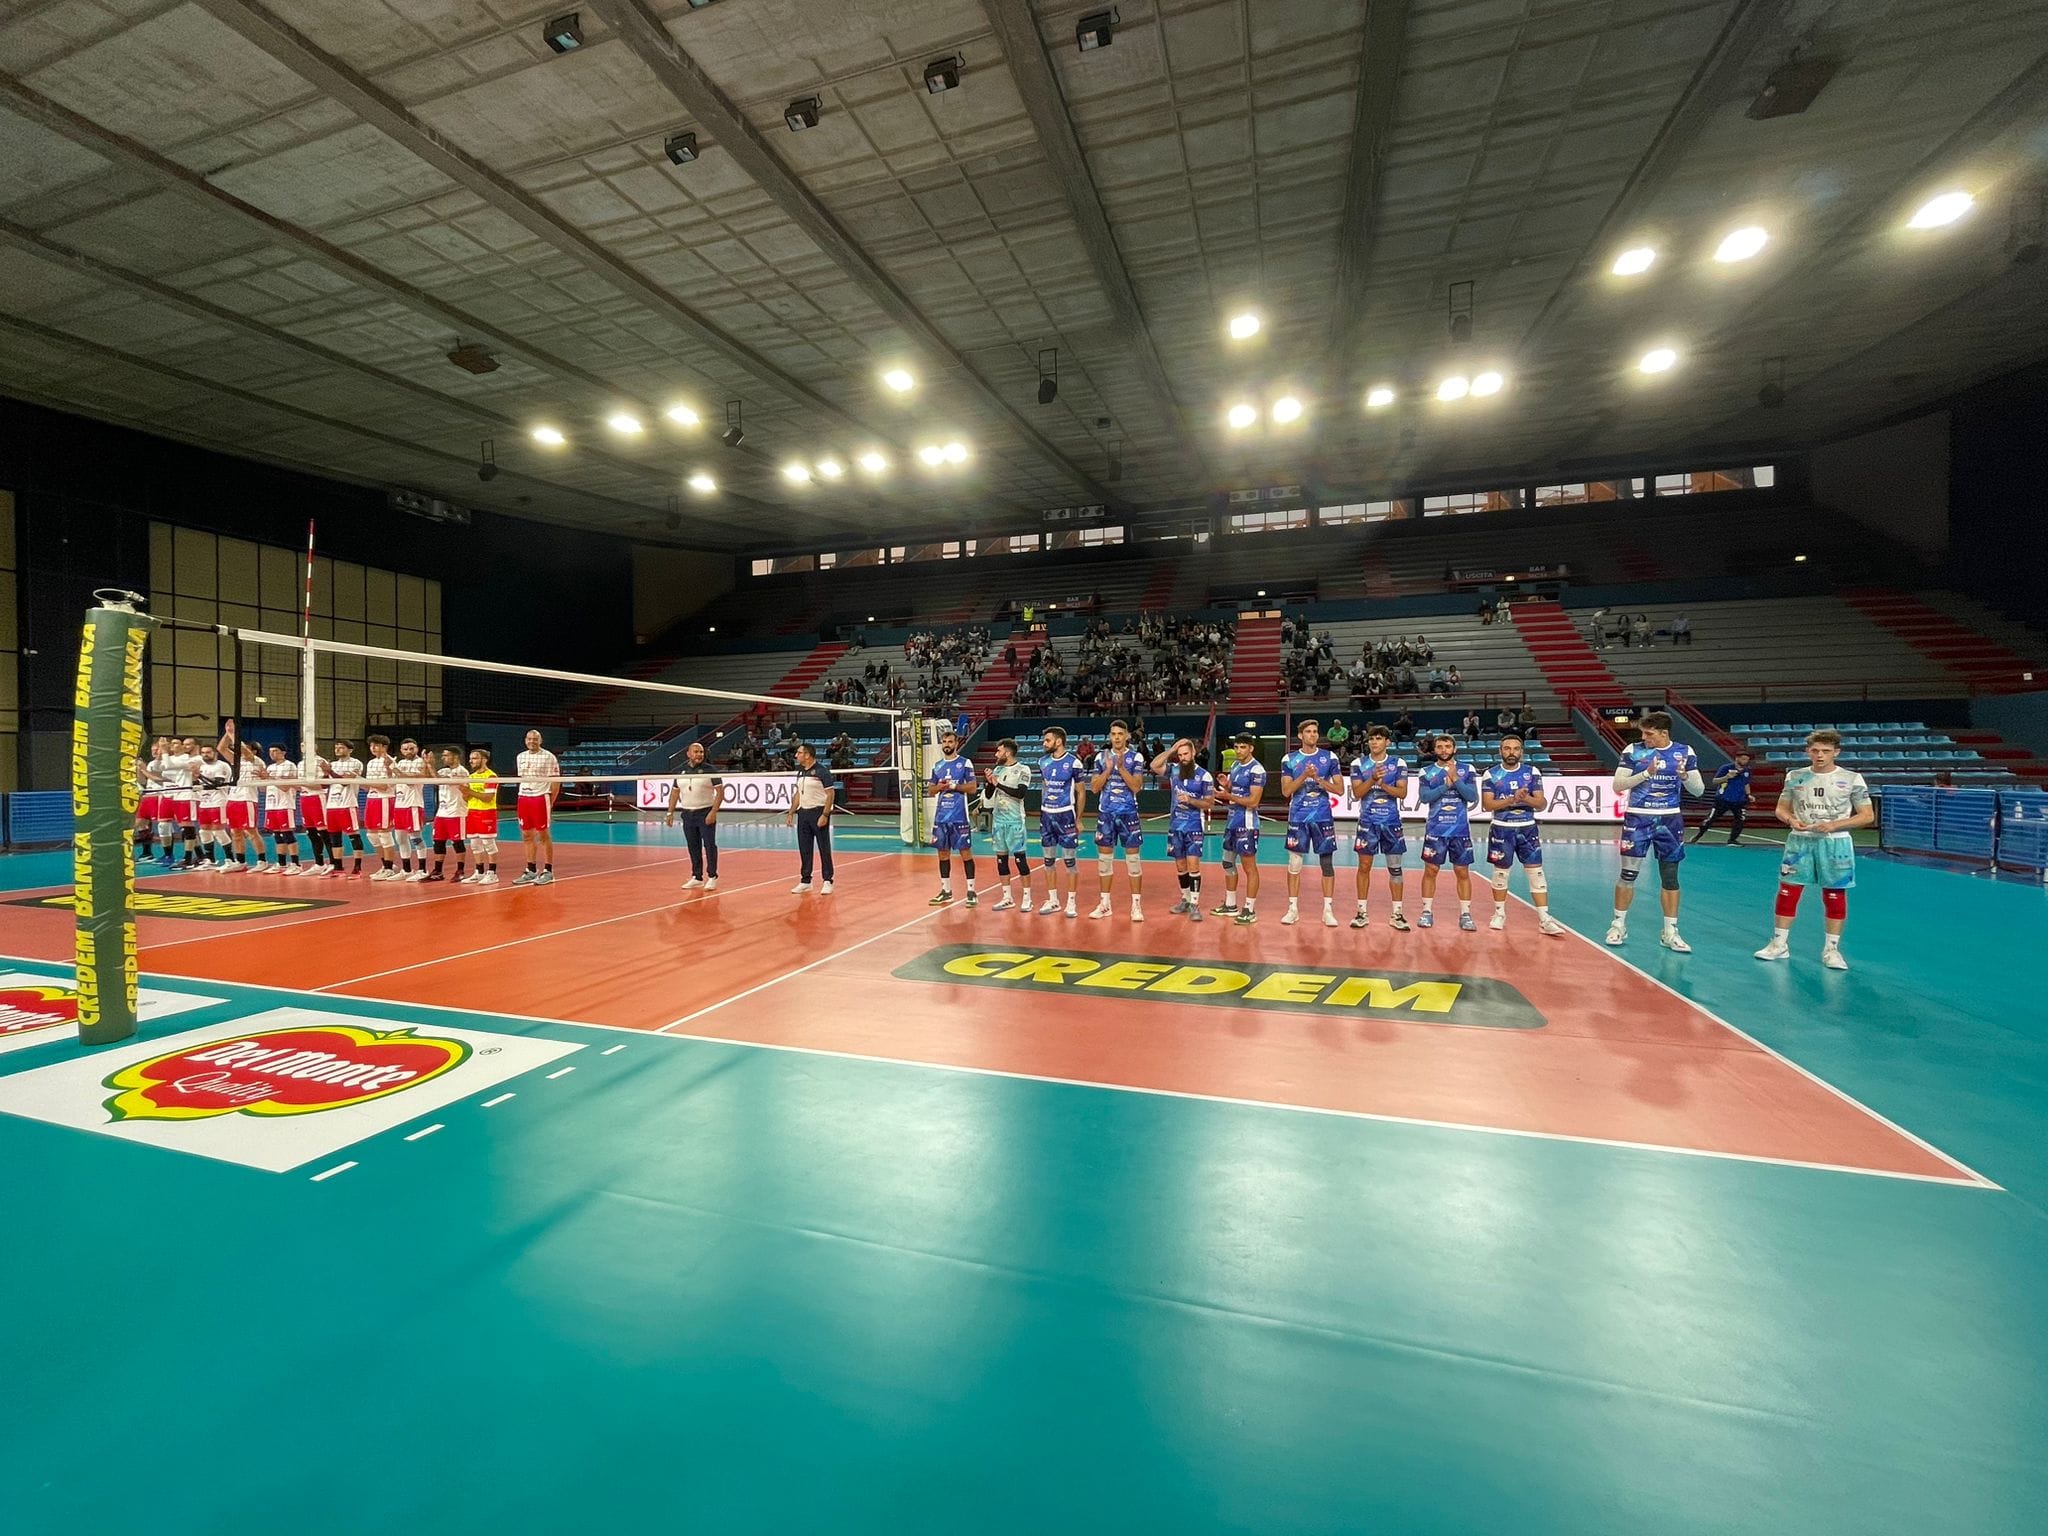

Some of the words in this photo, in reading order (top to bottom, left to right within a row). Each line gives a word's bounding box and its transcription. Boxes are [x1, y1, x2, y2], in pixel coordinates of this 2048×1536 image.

[75, 623, 97, 708] BANCA
[73, 720, 90, 817] CREDEM
[120, 719, 143, 814] CREDEM
[1544, 784, 1600, 813] ARI
[1813, 787, 1825, 797] 10
[74, 832, 94, 918] BANCA
[76, 930, 101, 1026] CREDEM
[123, 922, 138, 1014] CREDEM
[942, 952, 1464, 1014] CREDEM
[171, 1071, 283, 1103] Quality
[182, 1041, 297, 1068] Del
[247, 1050, 418, 1091] Monte
